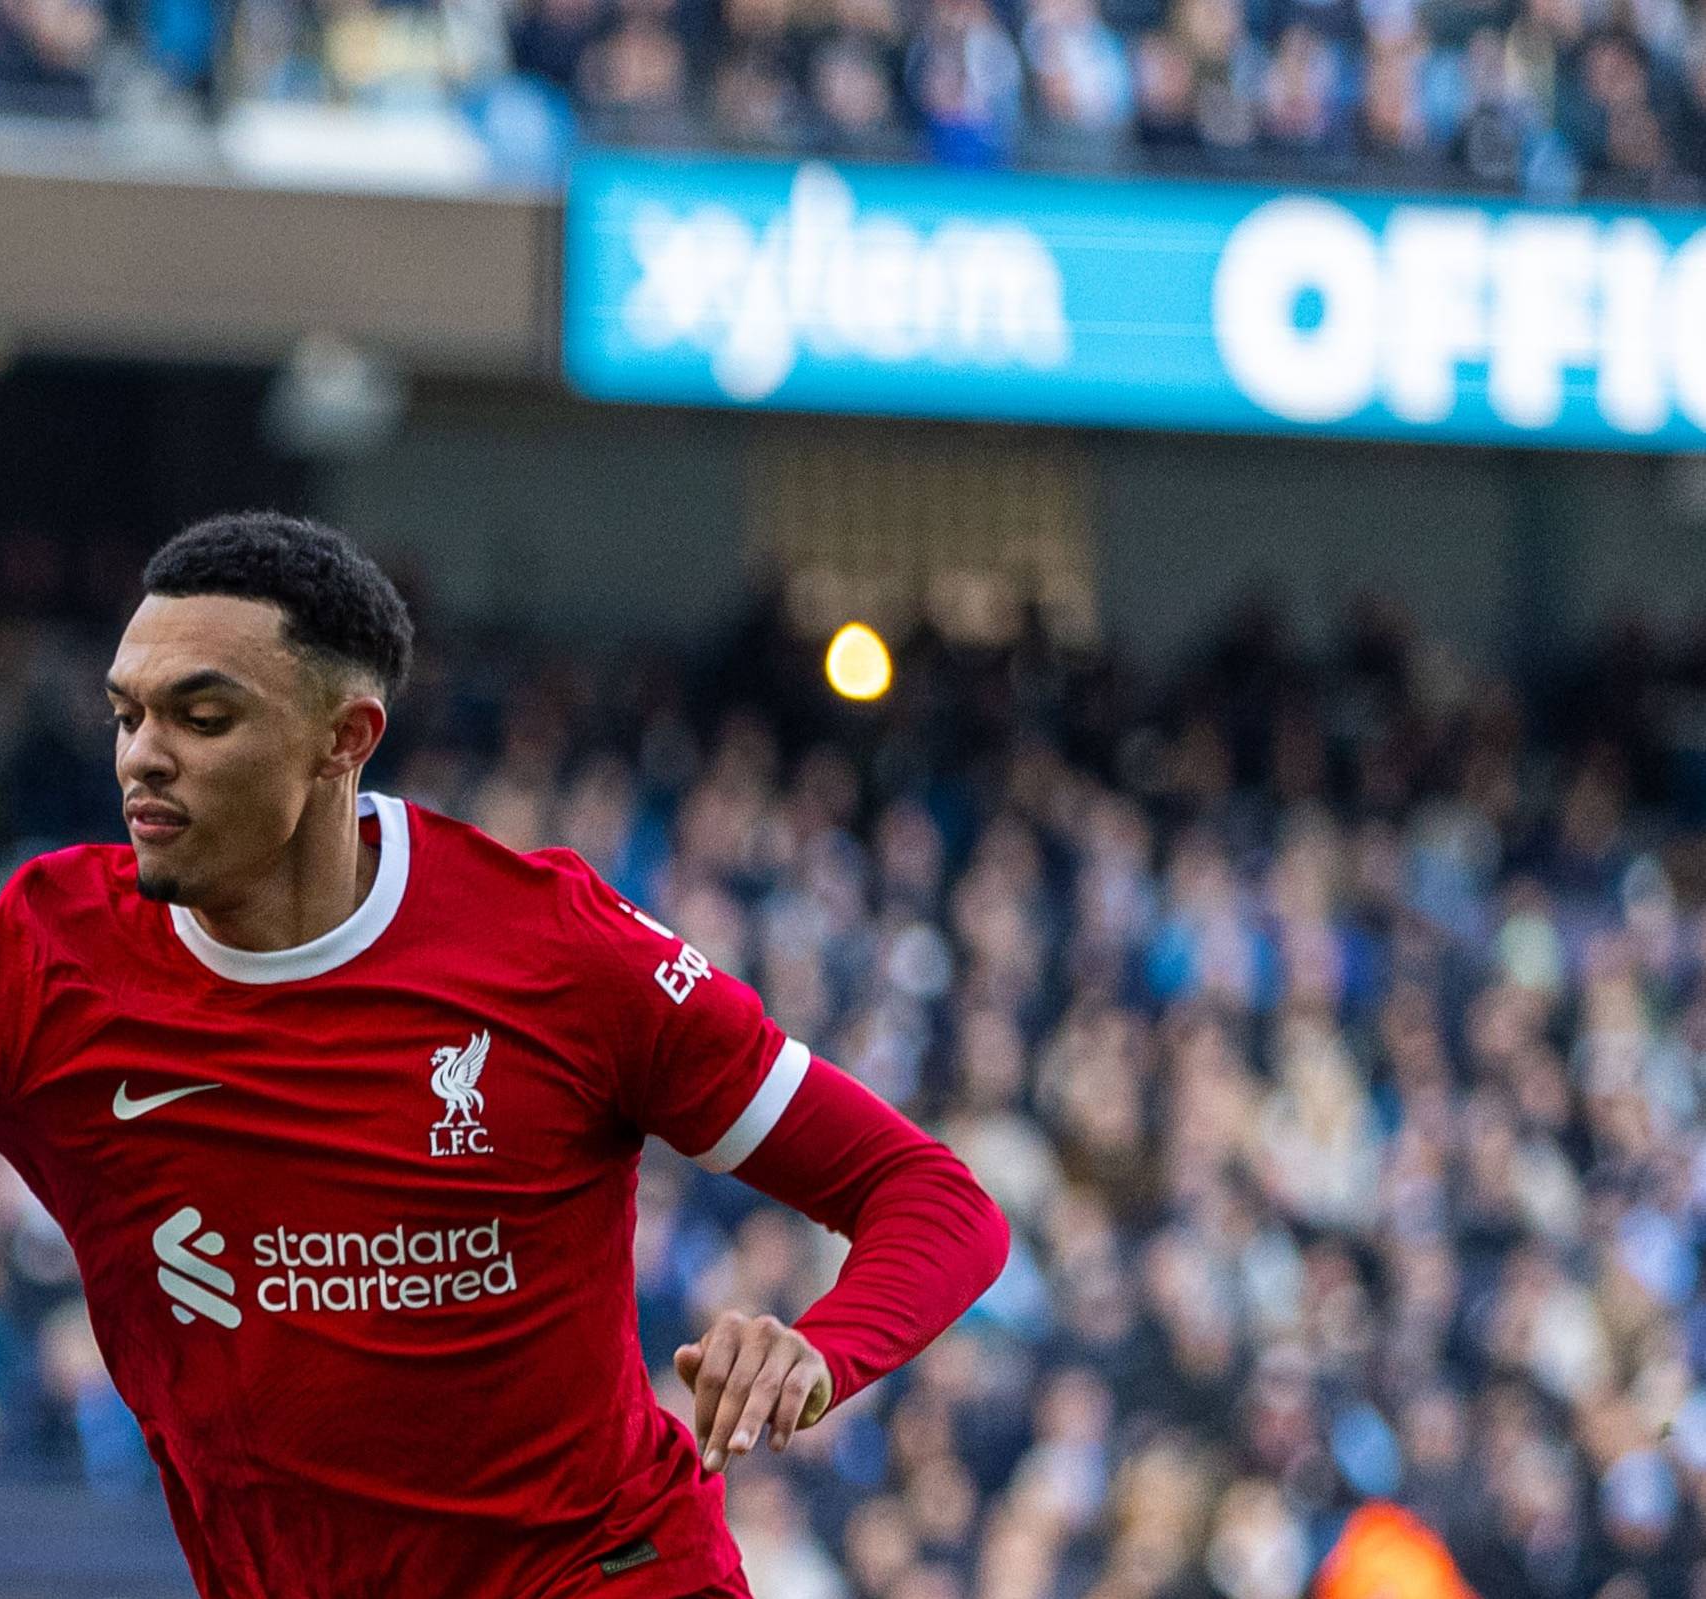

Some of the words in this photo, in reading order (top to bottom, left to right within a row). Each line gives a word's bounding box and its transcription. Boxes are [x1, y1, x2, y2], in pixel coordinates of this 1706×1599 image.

[624, 158, 1073, 402] xylem
[1211, 194, 1706, 435] OFFI
[253, 1217, 500, 1267] standard
[257, 1251, 518, 1313] chartered
